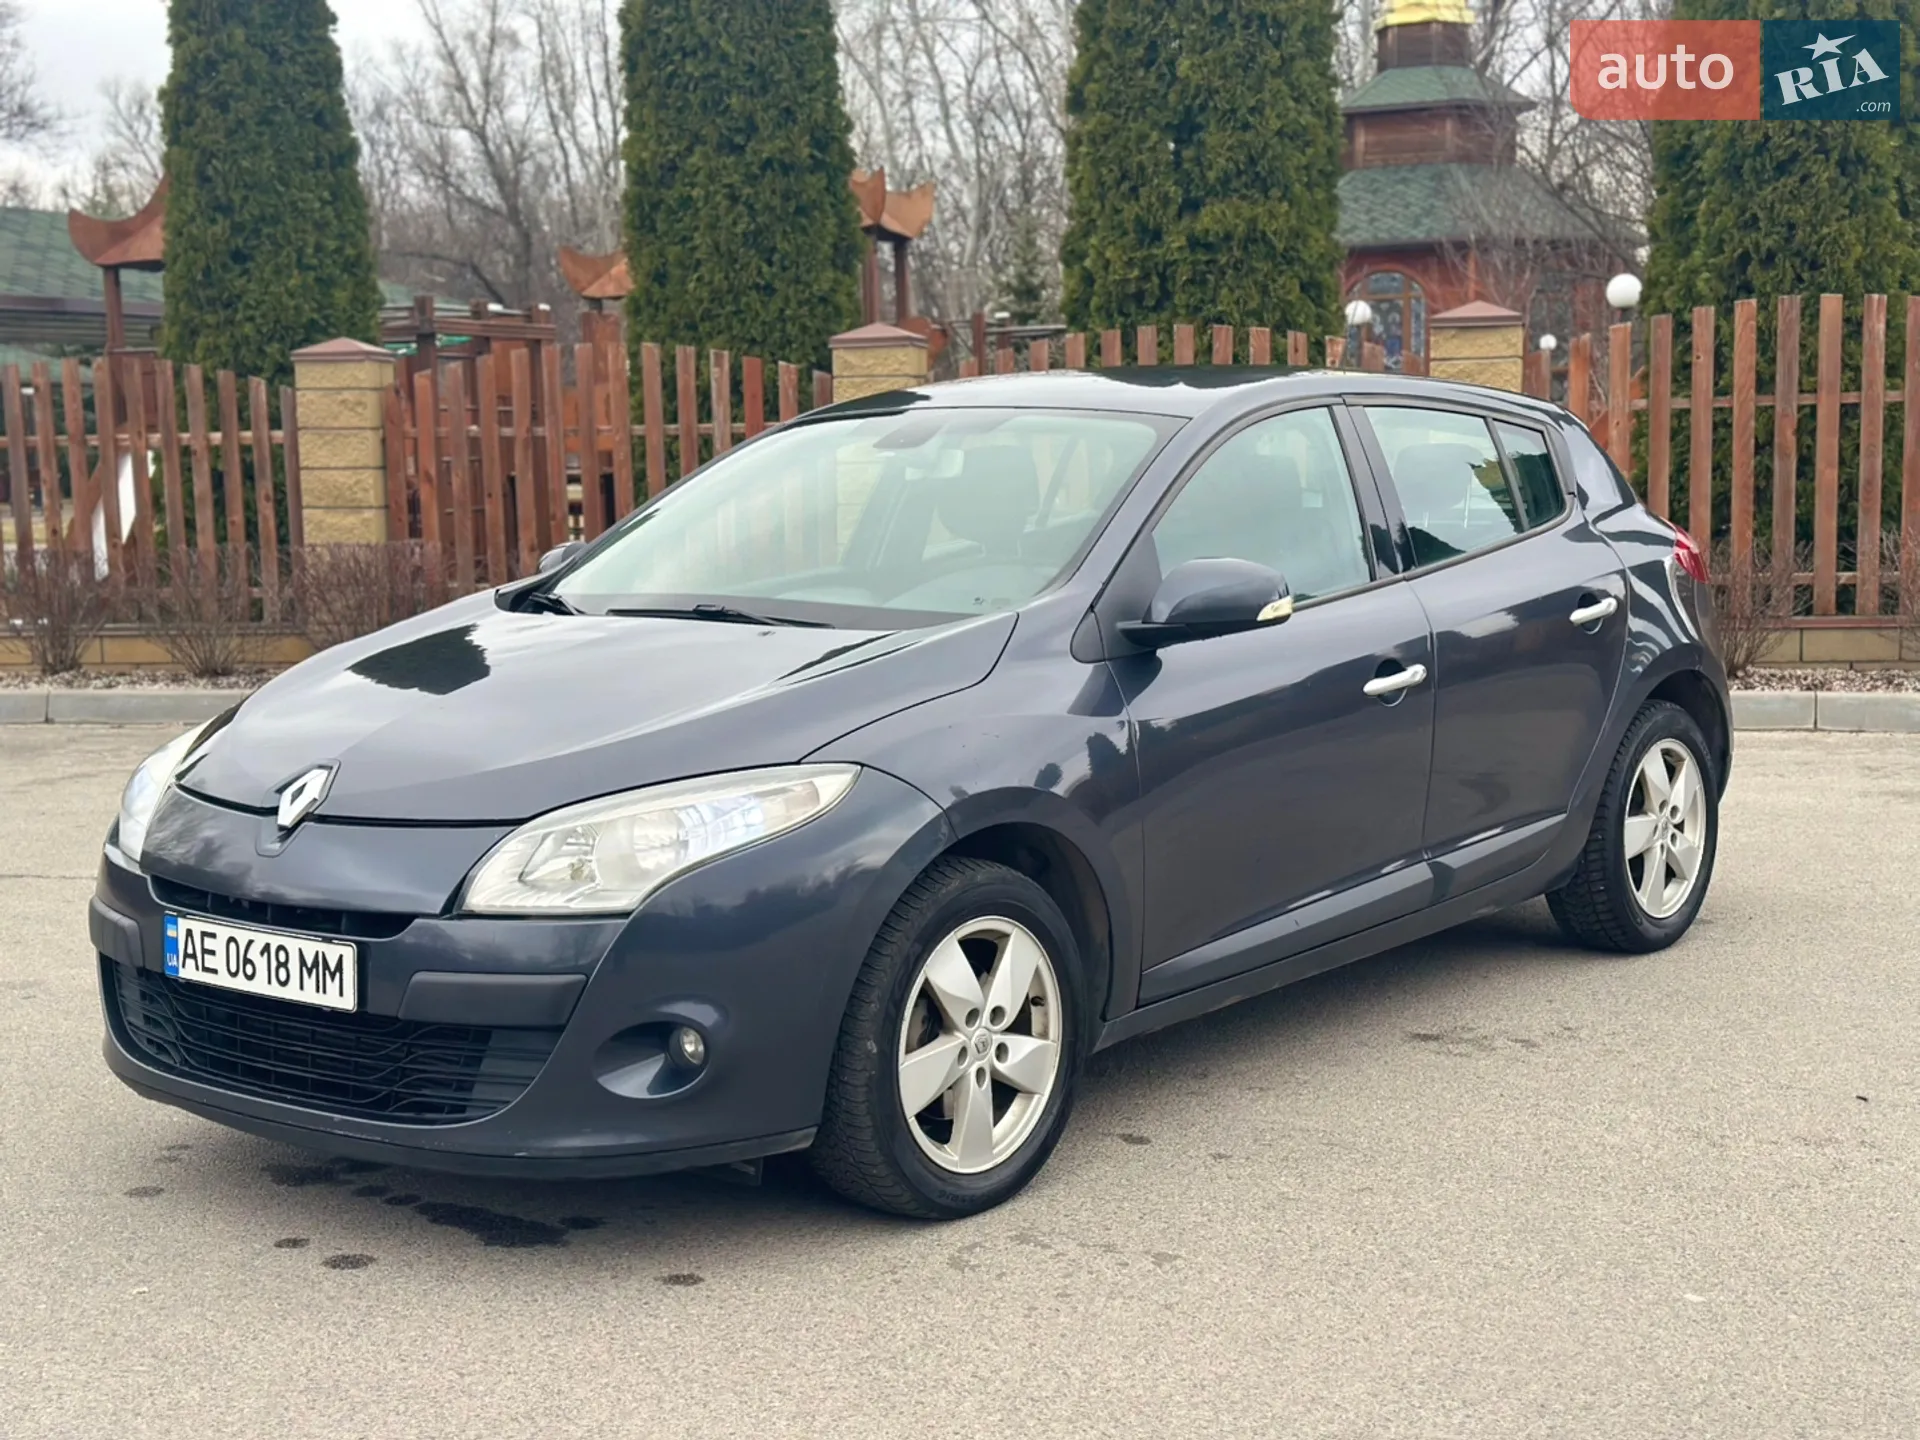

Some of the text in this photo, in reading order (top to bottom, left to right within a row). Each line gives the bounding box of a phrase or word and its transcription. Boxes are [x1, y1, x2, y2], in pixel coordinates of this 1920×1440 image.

[166, 953, 178, 967] UA
[181, 927, 344, 998] AE 0618 MM
